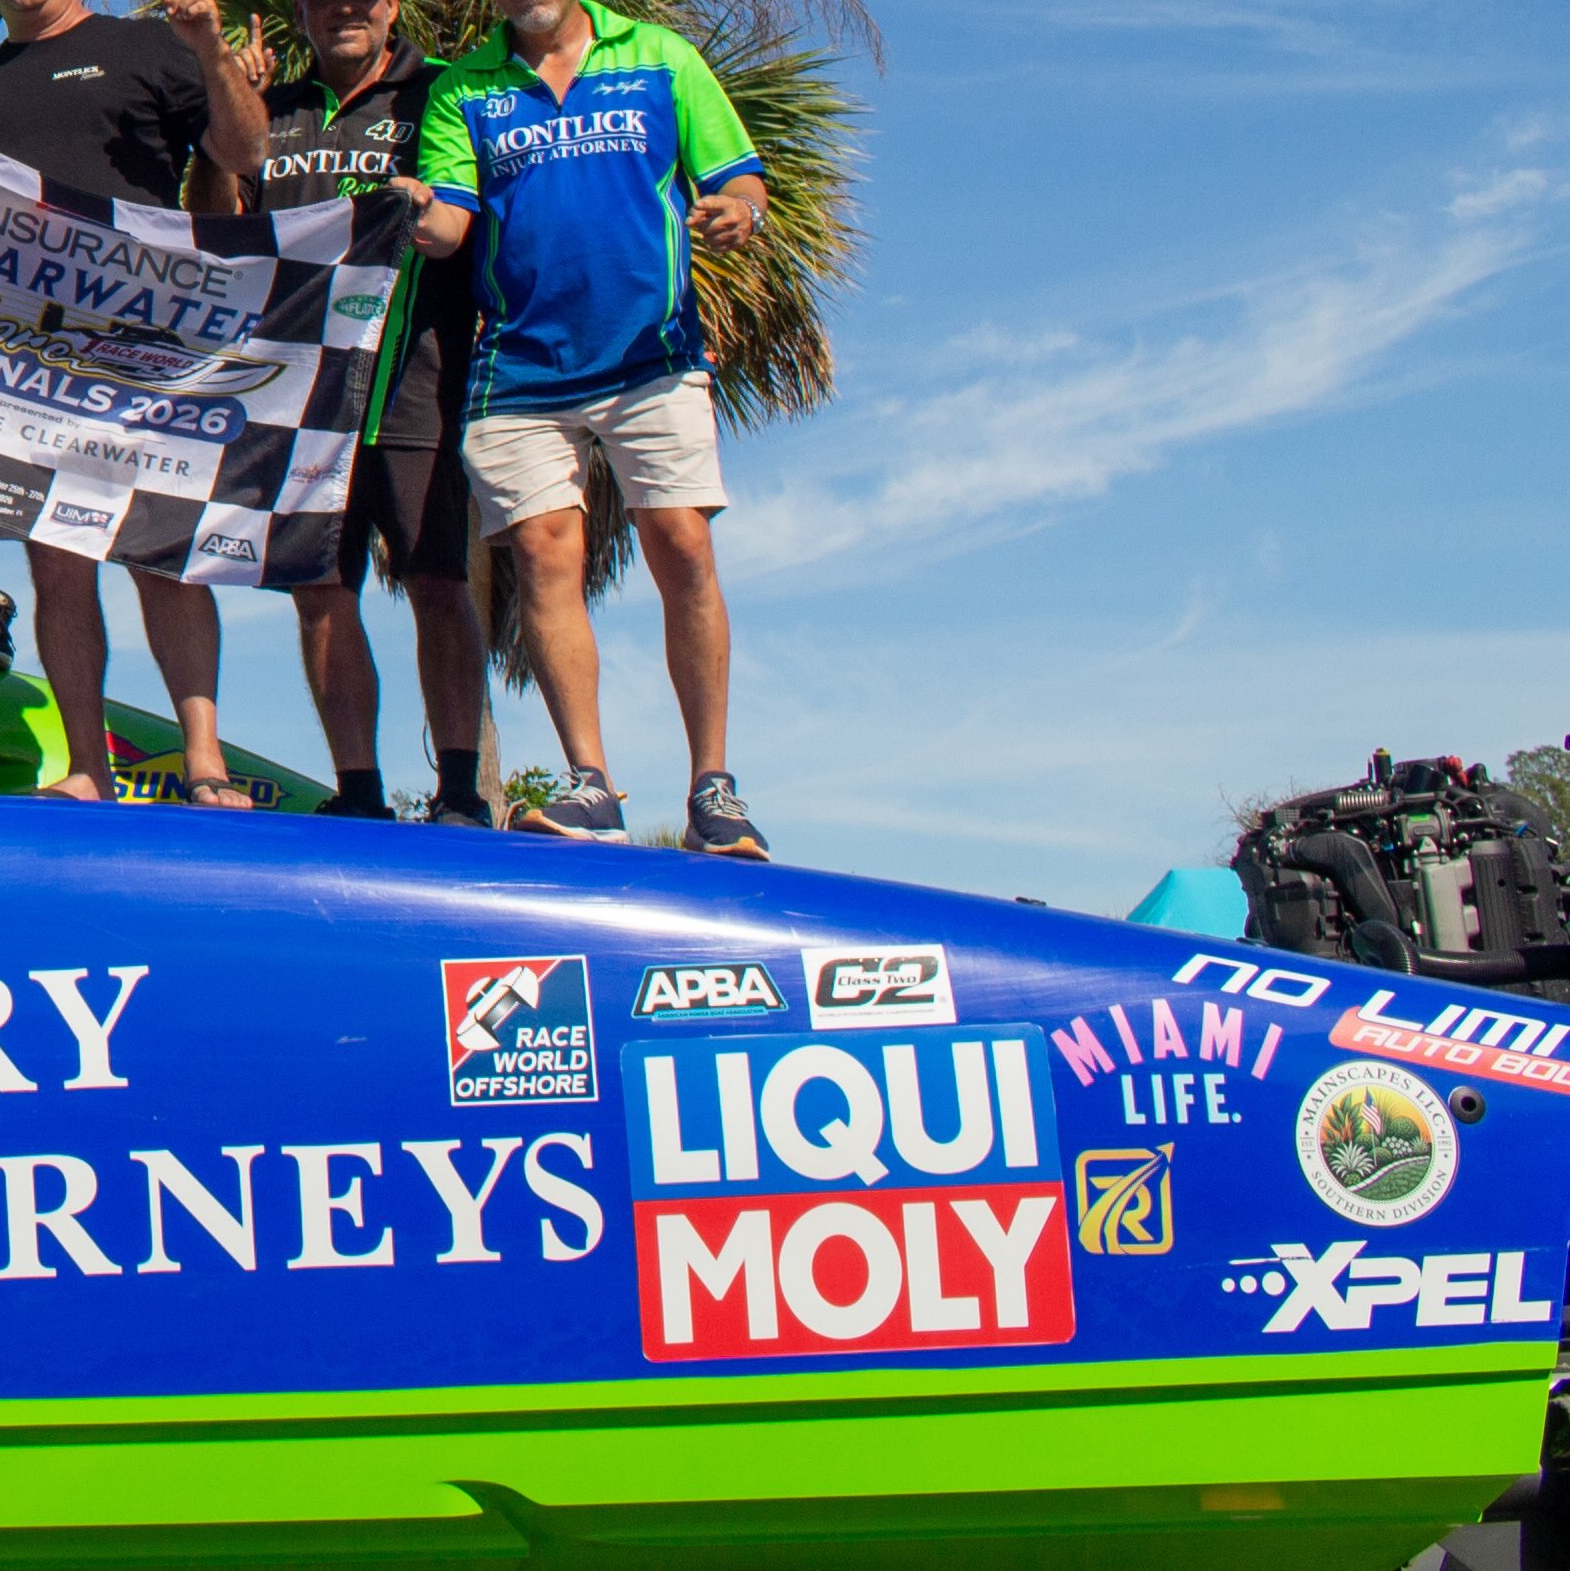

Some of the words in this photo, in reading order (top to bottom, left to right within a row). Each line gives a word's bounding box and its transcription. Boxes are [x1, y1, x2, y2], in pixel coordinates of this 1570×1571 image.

[482, 94, 517, 119] 40
[365, 119, 415, 144] 40
[482, 109, 648, 161] MONTLICK
[492, 150, 546, 179] INJURY
[549, 139, 648, 160] ATTORNEYS
[96, 343, 138, 361] RACE
[139, 350, 194, 370] WORLD
[66, 417, 83, 431] by
[119, 395, 232, 435] 2026
[19, 423, 191, 478] CLEARWATER
[202, 535, 254, 561] APBA
[111, 770, 274, 804] SUNO
[642, 966, 780, 1013] APBA
[814, 955, 940, 1008] C2
[837, 973, 882, 987] Class
[885, 973, 917, 985] Two
[515, 1025, 587, 1049] RACE
[1051, 998, 1283, 1088] MIAMI
[1352, 1025, 1483, 1065] AUTO
[492, 1048, 589, 1073] WORLD
[455, 1073, 588, 1099] OFFSHORE
[1121, 1073, 1242, 1125] LIFE.
[1302, 1066, 1412, 1126] MAINSCAPES
[1415, 1089, 1446, 1128] LLC
[643, 1039, 1039, 1186] LIQUI
[1310, 1170, 1386, 1220] SOUTHERN
[1392, 1169, 1448, 1220] DIVISION
[656, 1195, 1058, 1345] MOLY
[1261, 1239, 1553, 1334] XPEL
